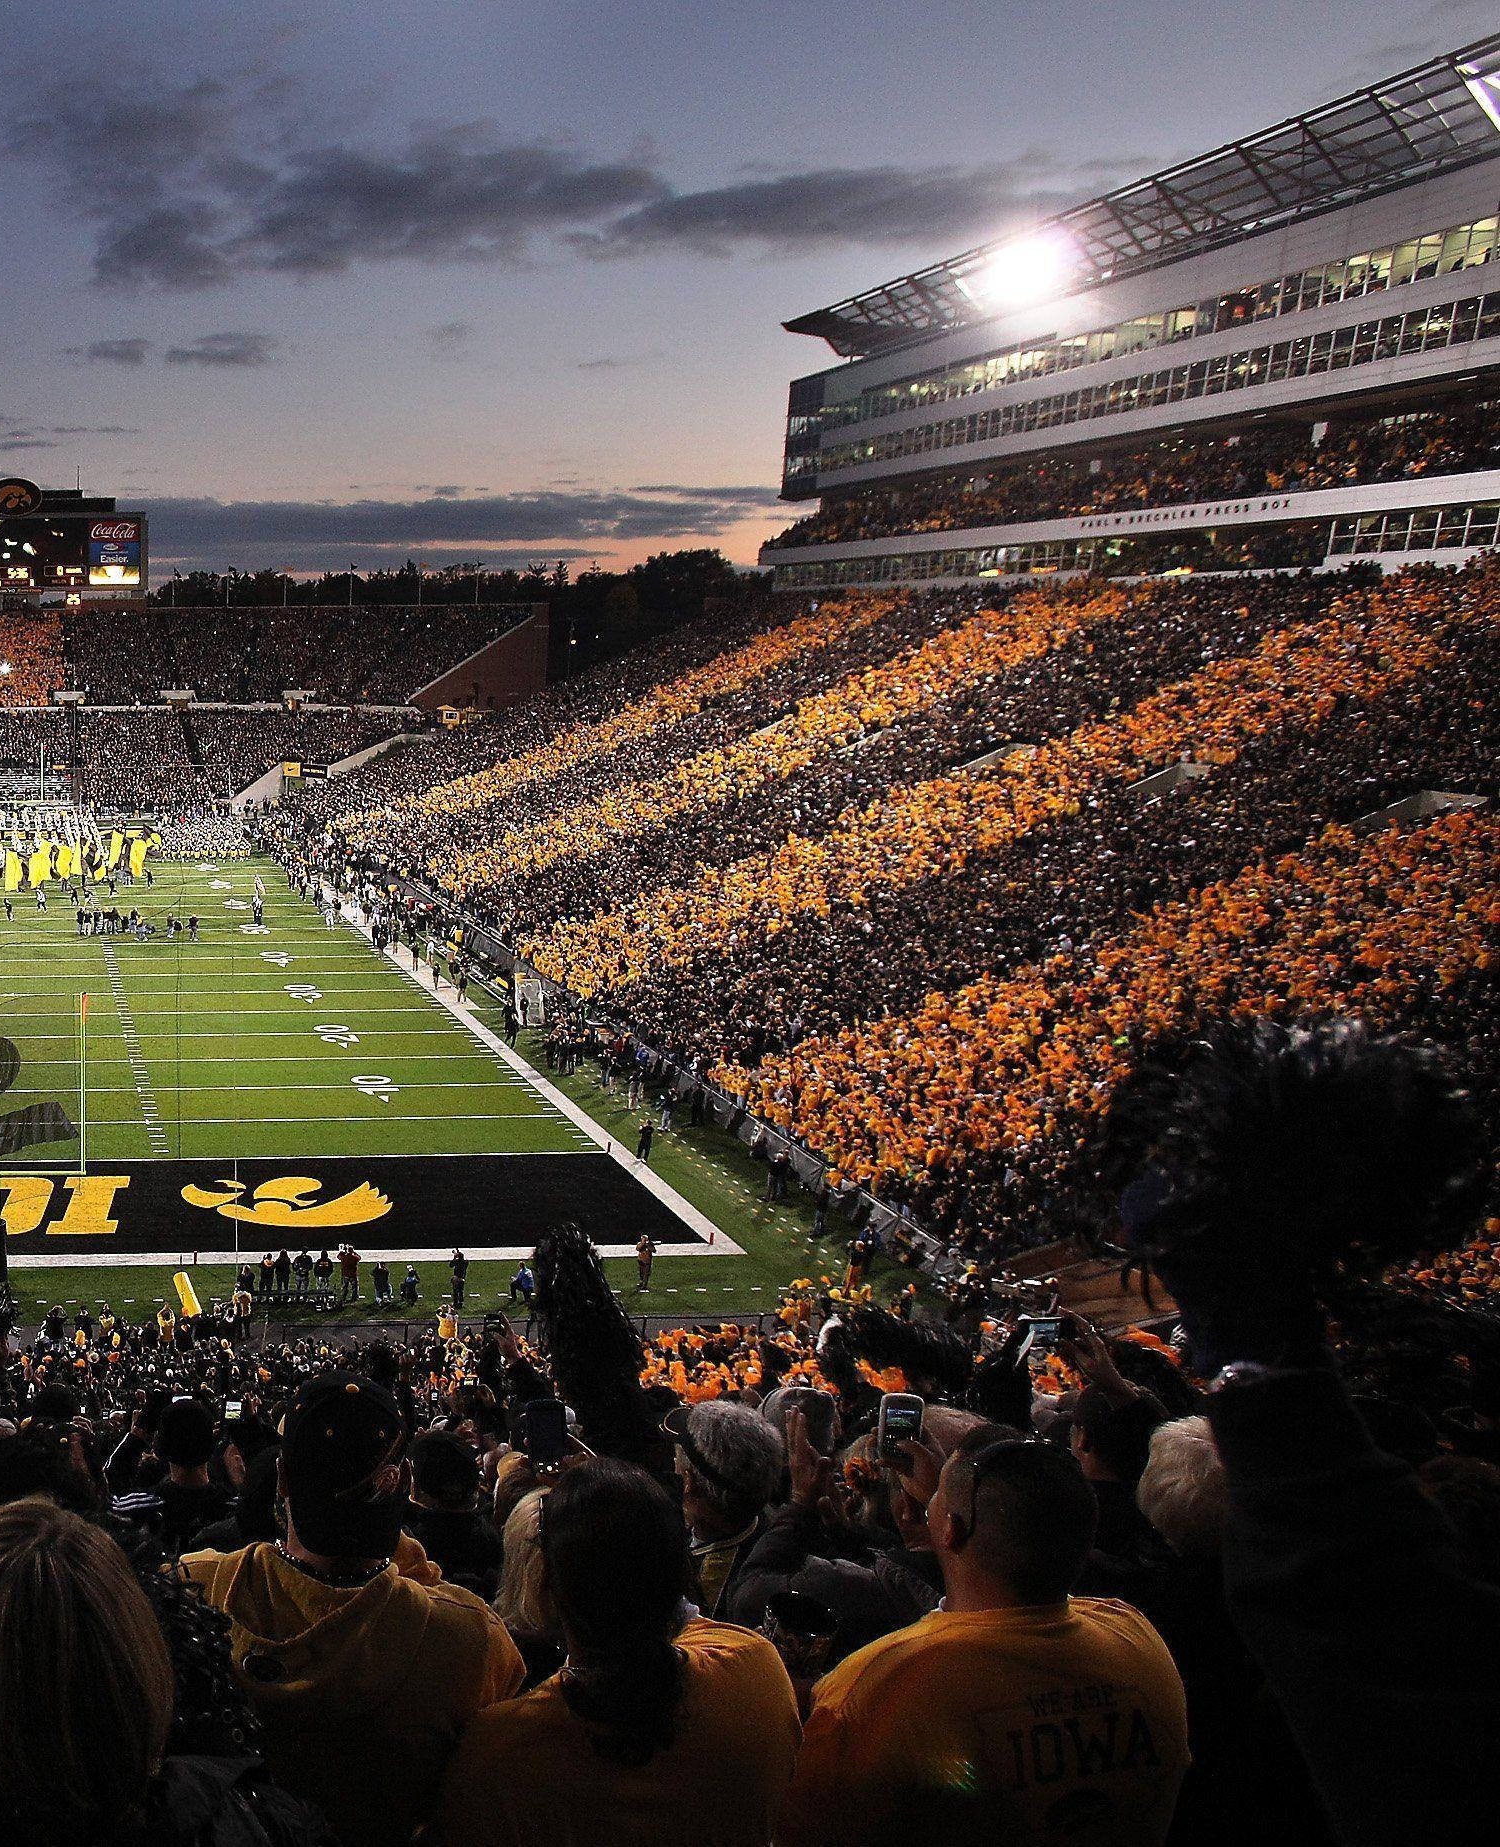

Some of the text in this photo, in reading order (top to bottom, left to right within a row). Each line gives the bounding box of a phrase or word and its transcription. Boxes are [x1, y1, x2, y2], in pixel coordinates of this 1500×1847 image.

[1204, 503, 1250, 516] PRESS
[1260, 499, 1291, 512] BOX
[100, 554, 129, 563] Easier.
[283, 983, 323, 999] 30
[312, 1024, 360, 1044] 20
[350, 1075, 400, 1097] 10
[1028, 1690, 1063, 1716] WE
[1006, 1708, 1162, 1790] IOWA
